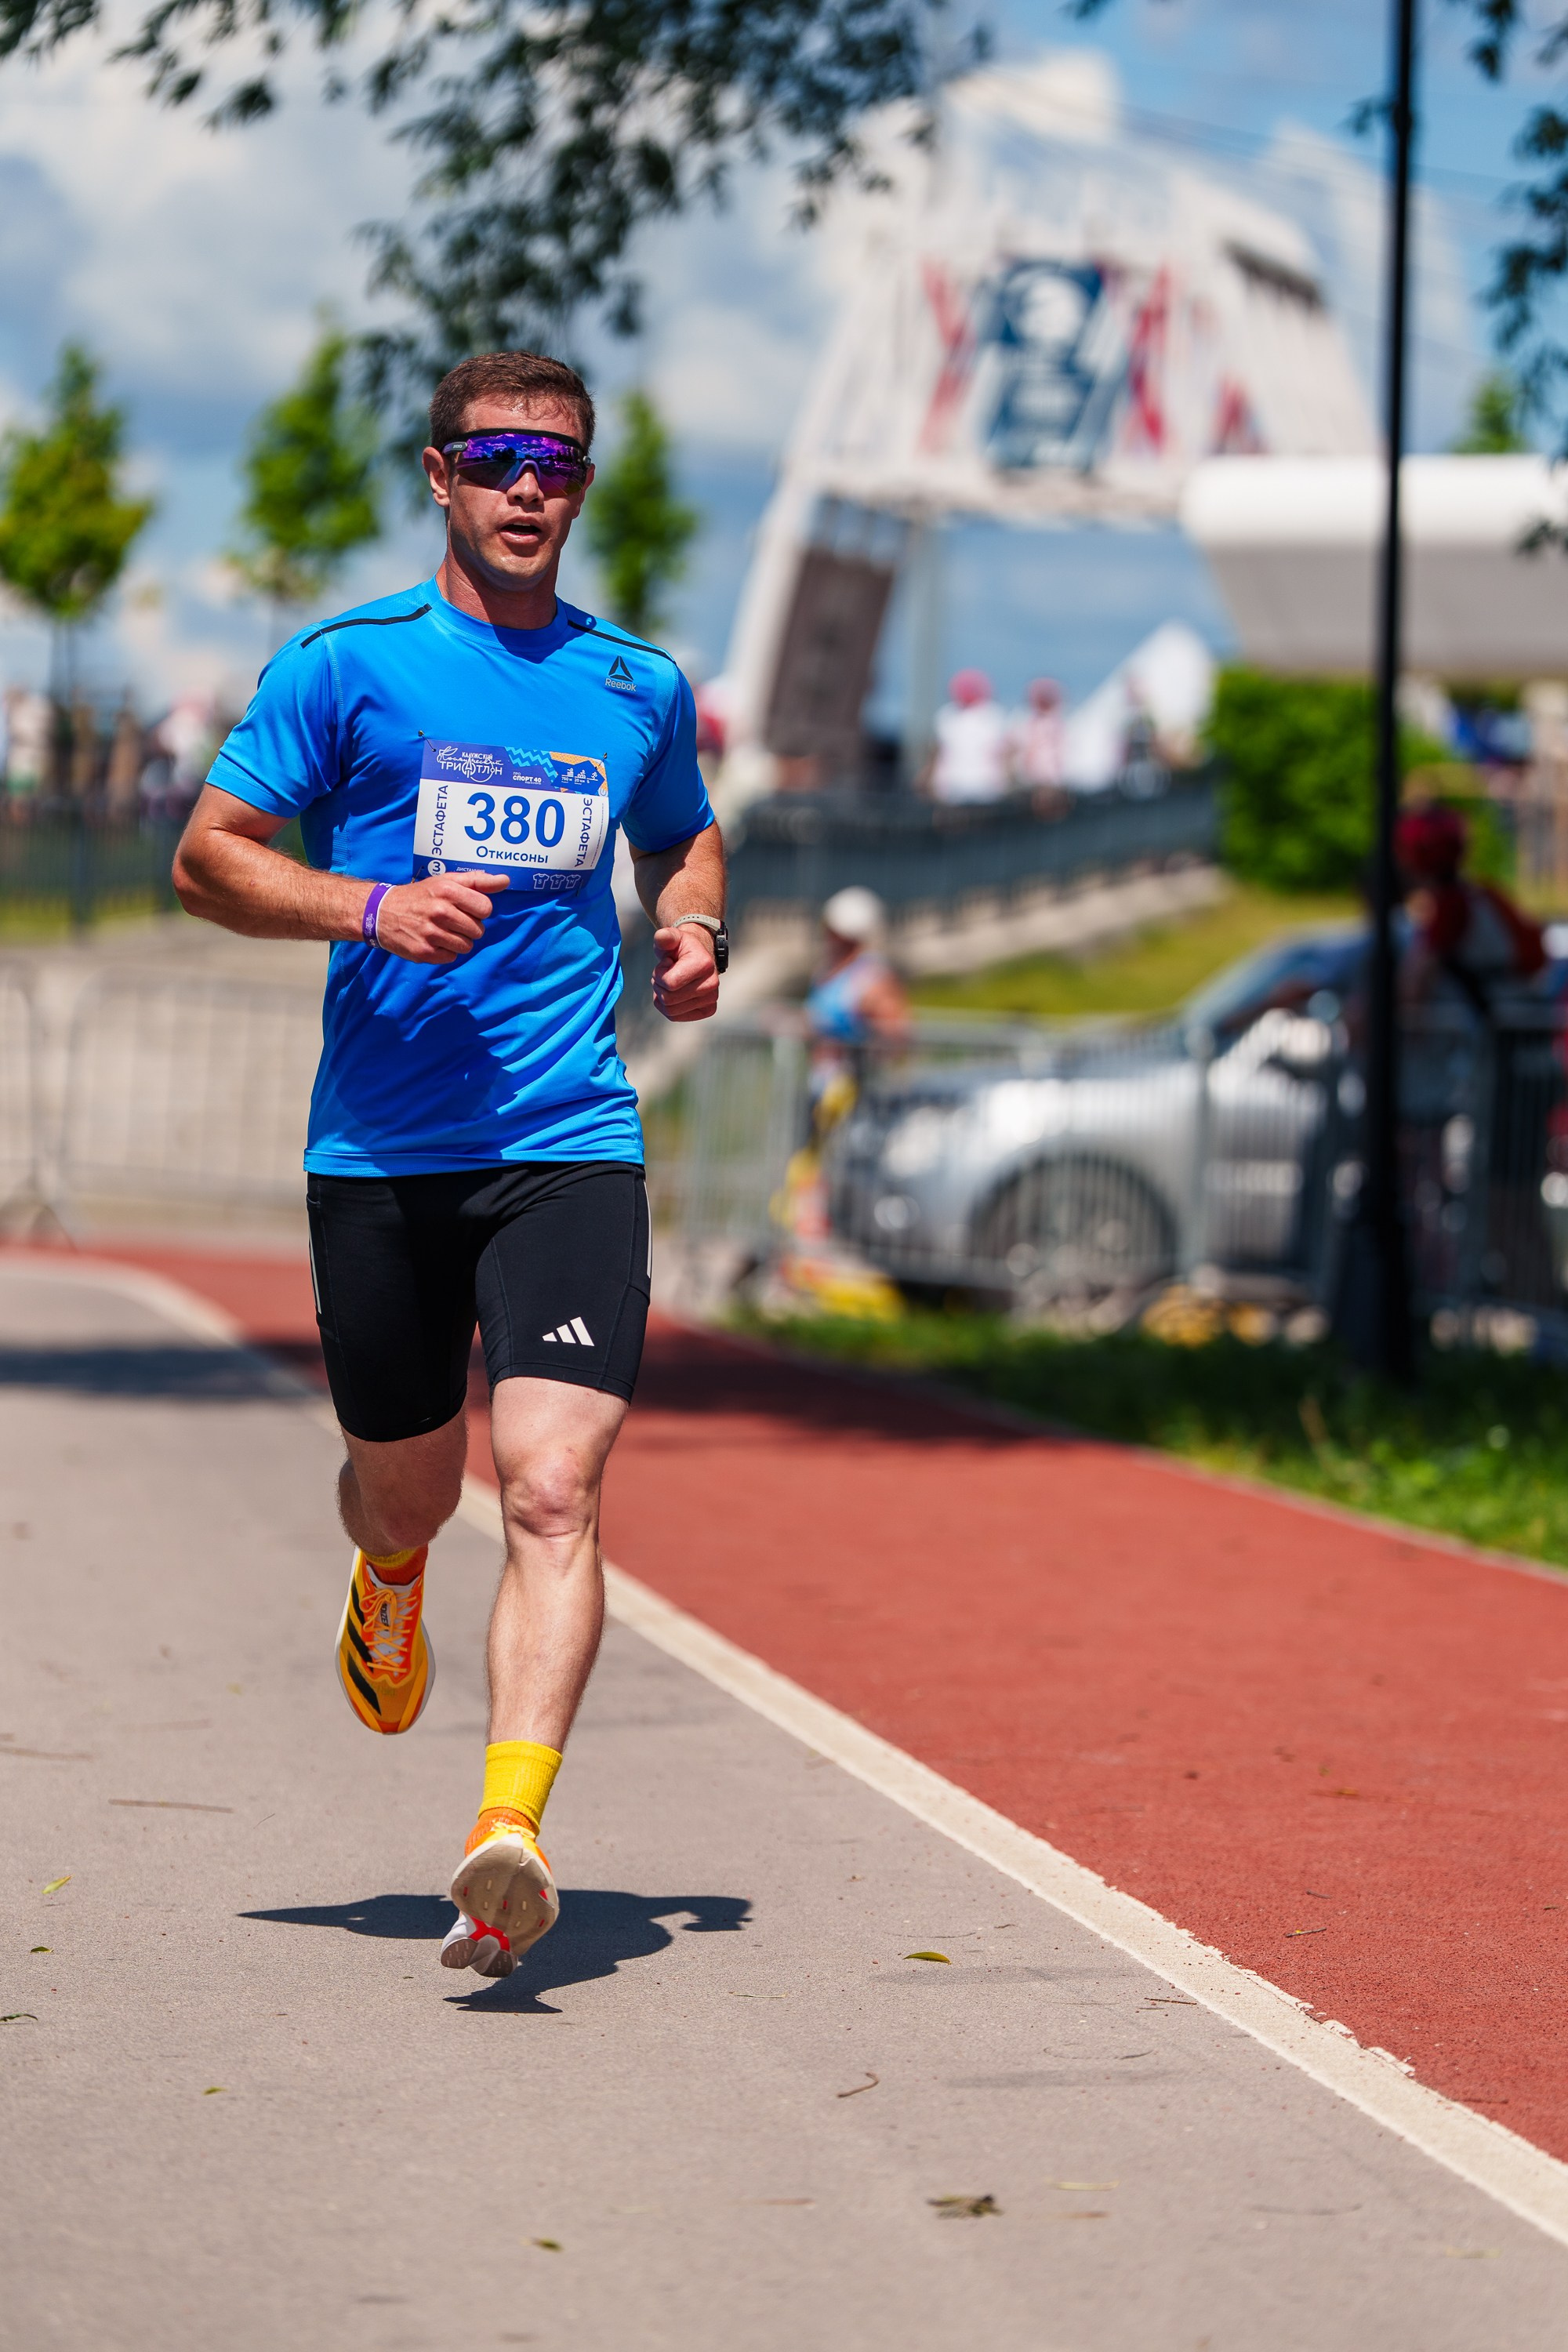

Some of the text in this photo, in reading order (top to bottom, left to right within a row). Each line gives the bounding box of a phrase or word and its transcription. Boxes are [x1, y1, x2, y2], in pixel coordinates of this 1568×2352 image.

[604, 677, 637, 691] Reebok
[432, 785, 448, 855] ЭСТАФЕТА
[464, 792, 565, 848] 380
[575, 797, 593, 867] ЭСТАФЕТА
[432, 861, 441, 872] 3
[476, 845, 549, 864] Откисоны
